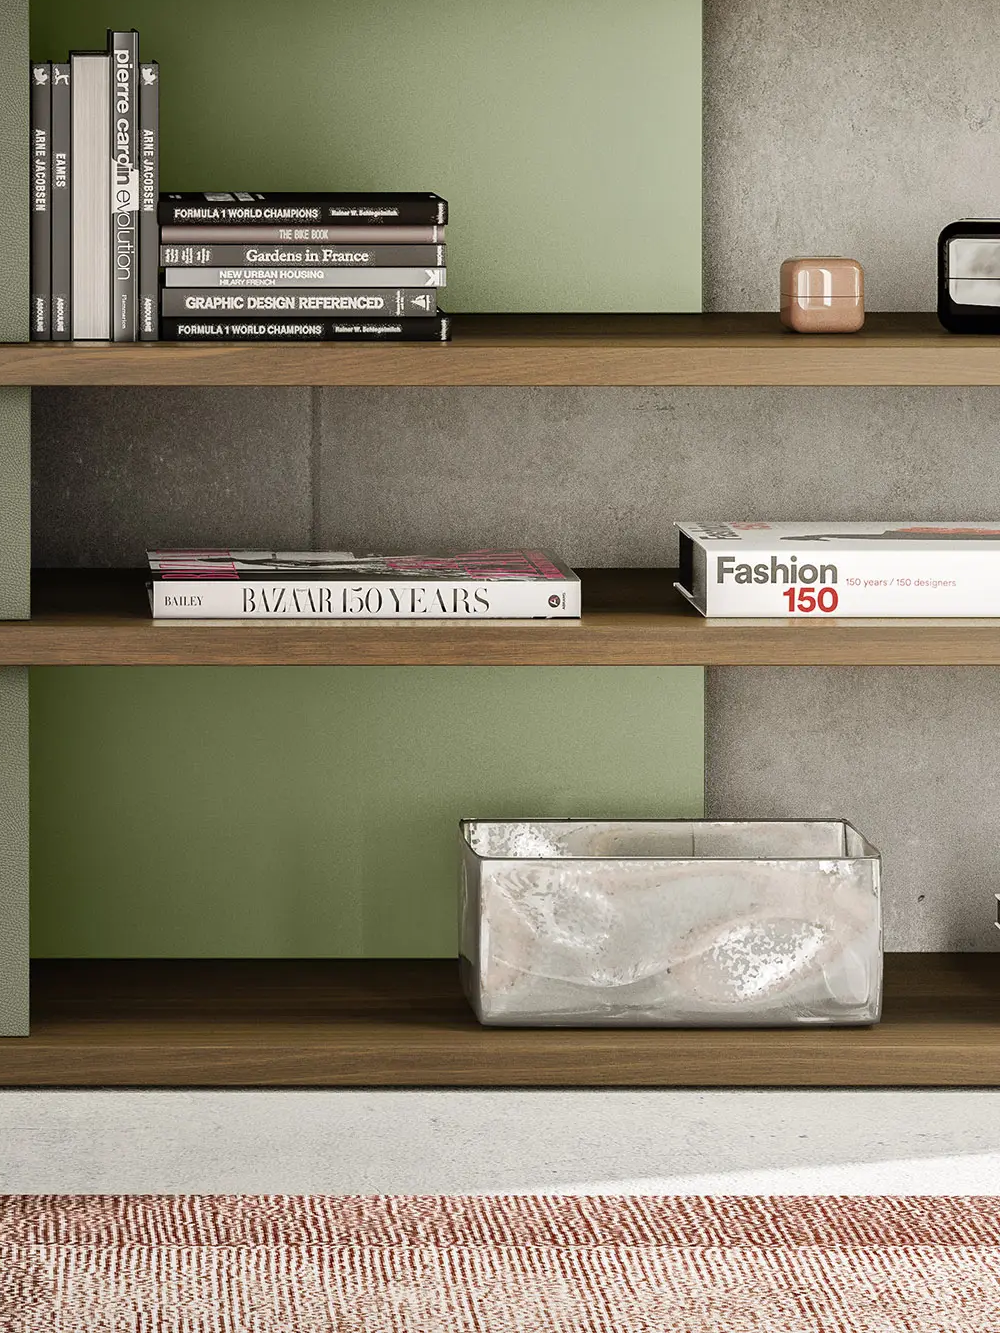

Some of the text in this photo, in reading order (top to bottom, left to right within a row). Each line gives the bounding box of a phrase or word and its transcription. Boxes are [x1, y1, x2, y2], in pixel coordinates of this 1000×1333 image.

[143, 129, 154, 211] ARNE JACOBSEN
[175, 209, 318, 218] FORMULA 1 WORLD CHAMPIONS
[186, 297, 244, 309] GRAPHIC
[248, 297, 294, 309] DESIGN
[299, 297, 384, 309] REFERENCED
[717, 556, 838, 584] Fashion
[863, 579, 888, 588] years
[914, 579, 956, 588] designers
[164, 596, 203, 606] BAILEY
[242, 588, 490, 613] BAZAAR 150 YEARS
[783, 587, 839, 612] 150
